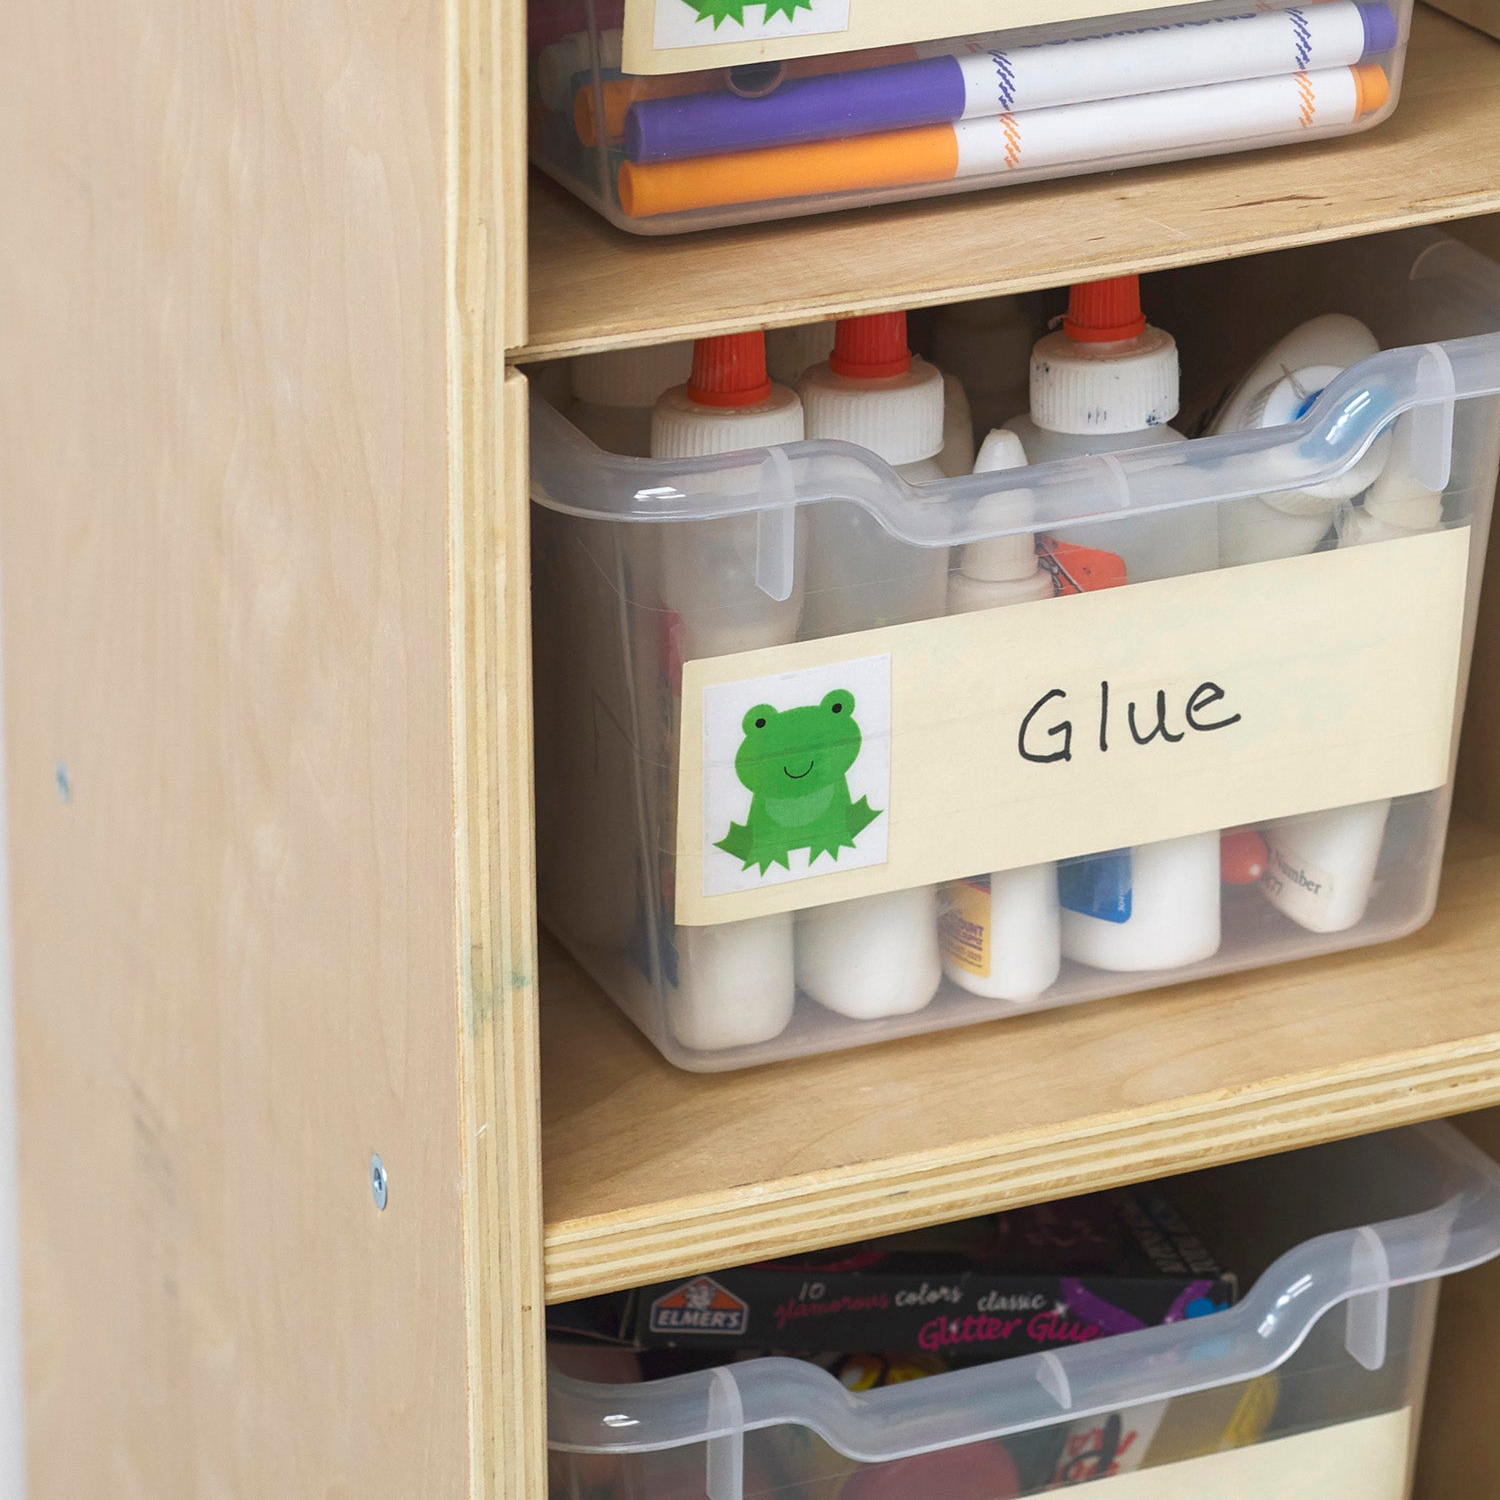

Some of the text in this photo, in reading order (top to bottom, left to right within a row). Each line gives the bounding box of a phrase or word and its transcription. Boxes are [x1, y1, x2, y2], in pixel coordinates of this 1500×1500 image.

[1018, 680, 1243, 765] Glue
[798, 1280, 827, 1301] 10
[894, 1281, 963, 1307] colors
[976, 1289, 1047, 1312] classic
[917, 1308, 1100, 1350] Glitter Glue
